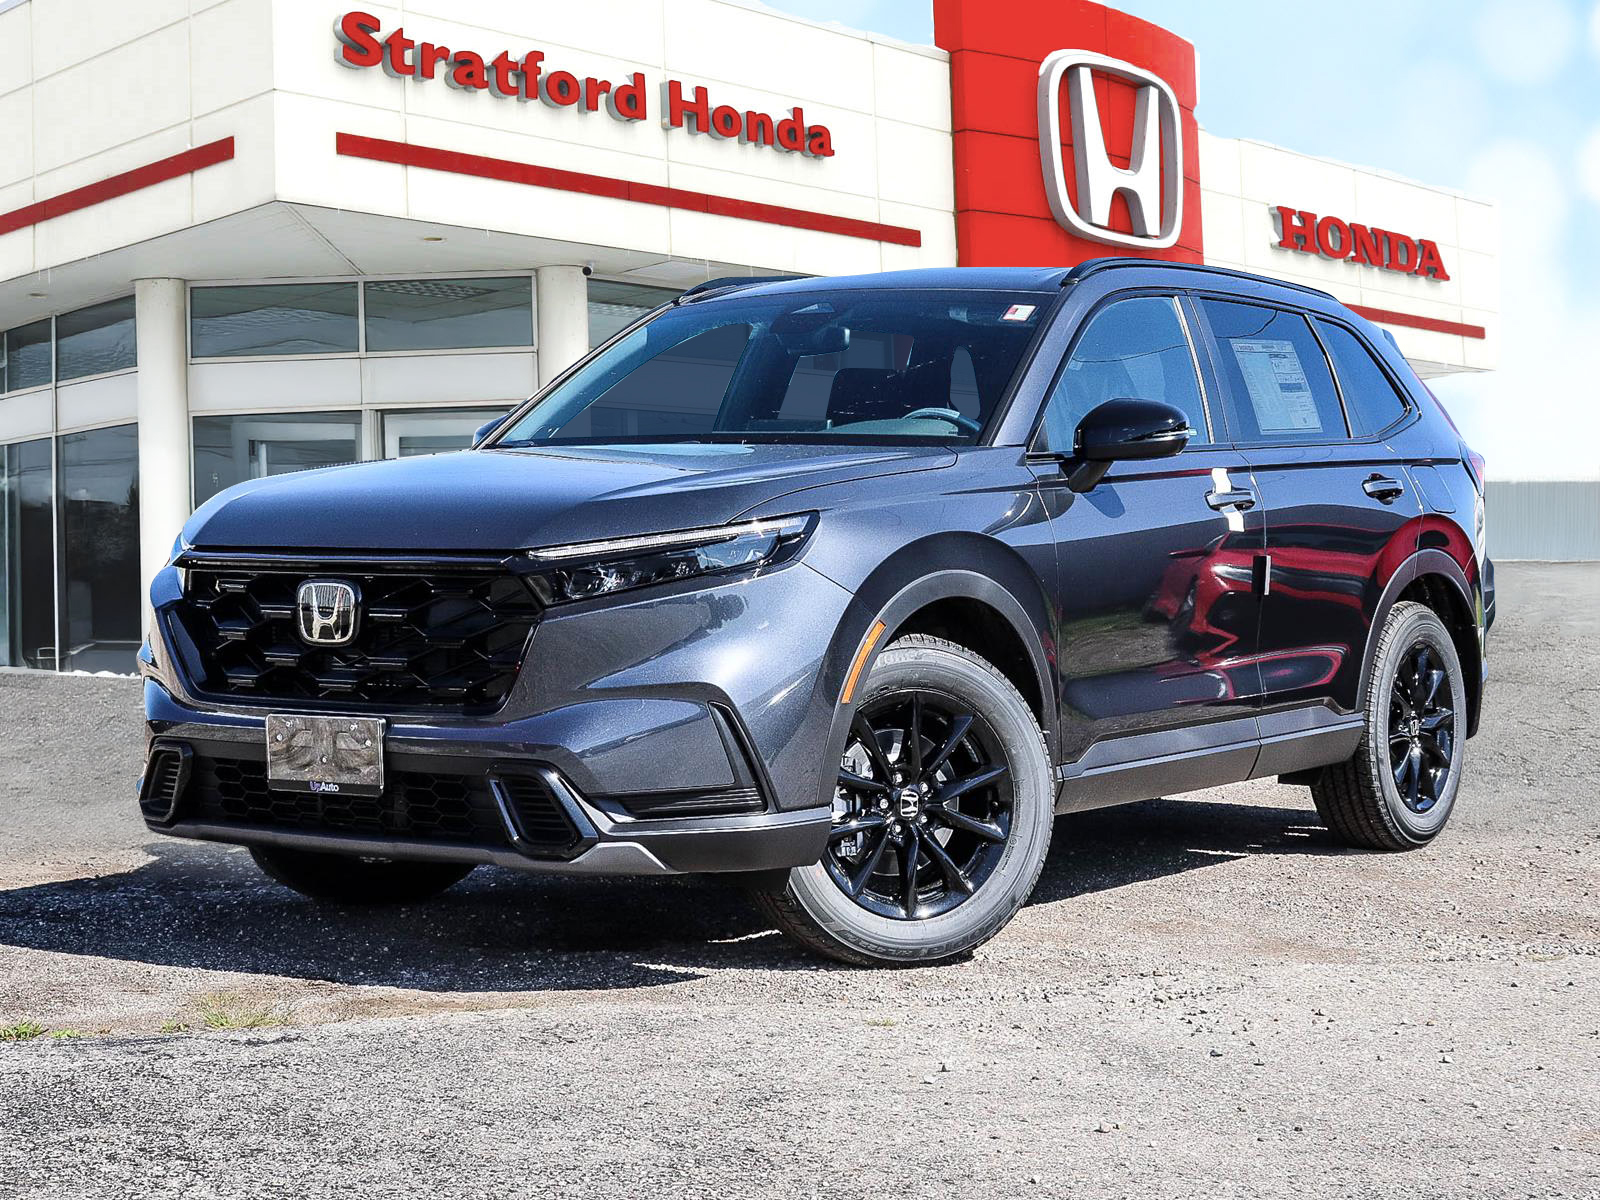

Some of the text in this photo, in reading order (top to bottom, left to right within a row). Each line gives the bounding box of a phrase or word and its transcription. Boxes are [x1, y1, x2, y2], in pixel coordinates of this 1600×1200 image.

[334, 11, 834, 158] Stratford Honda
[1269, 206, 1450, 282] HONDA
